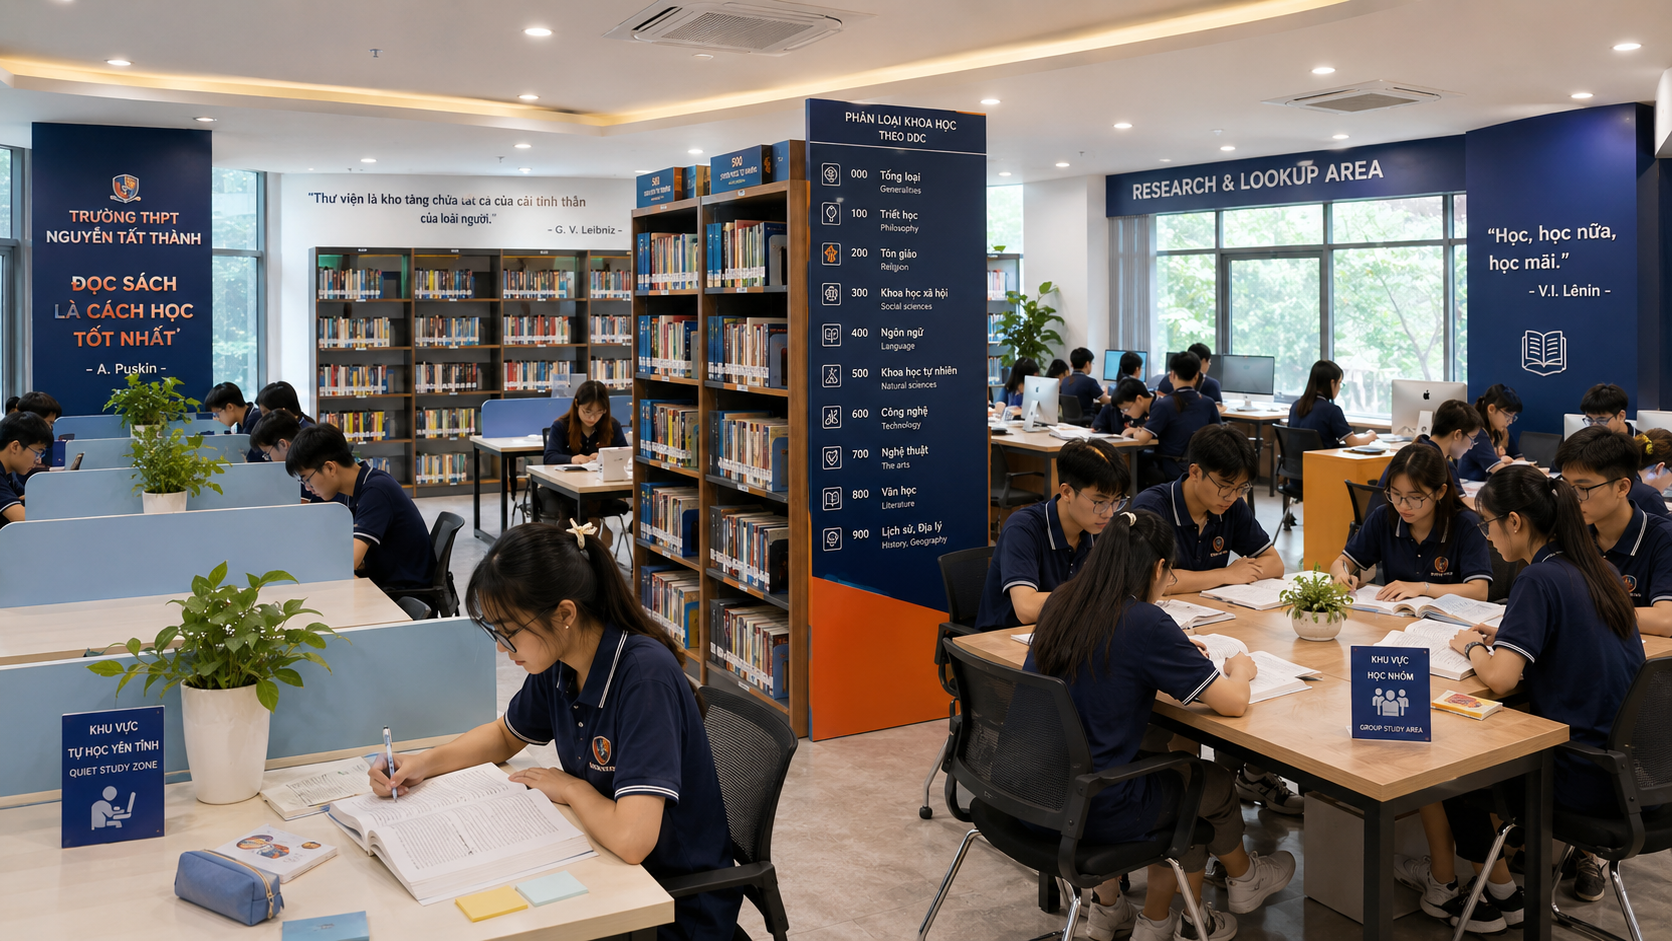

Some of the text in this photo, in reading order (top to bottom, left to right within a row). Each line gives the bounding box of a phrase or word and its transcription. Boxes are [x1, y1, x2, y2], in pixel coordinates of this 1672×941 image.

[877, 115, 902, 129] LOẠI
[904, 116, 933, 128] KHOA
[935, 119, 957, 132] HỌC
[878, 130, 926, 143] THEO DDC
[851, 169, 868, 179] 000
[1132, 159, 1384, 200] RESEARCH & LOOKUP AREA
[340, 193, 364, 206] viện
[381, 193, 402, 205] kho
[69, 208, 179, 224] TRƯỜNG THPT
[851, 208, 868, 218] 100
[902, 210, 918, 222] học
[117, 227, 146, 244] TẤT
[149, 229, 201, 246] THÀNH
[555, 225, 566, 235] G.
[568, 225, 579, 235] V.
[581, 225, 615, 235] Leibniz
[1538, 225, 1571, 245] học
[1577, 222, 1616, 241] nữa,
[851, 248, 868, 258] 200
[1489, 255, 1519, 274] học
[71, 272, 177, 295] ĐỌC SÁCH
[1538, 285, 1558, 297] V.I.
[1563, 283, 1600, 297] Lênin
[851, 288, 868, 297] 300
[880, 288, 903, 297] Khoa
[905, 288, 921, 300] học
[54, 300, 194, 323] LÀ CÁCH HỌC
[880, 302, 902, 311] Social
[73, 325, 114, 347] TỐT
[851, 328, 868, 338] 400
[881, 342, 915, 352] Language
[97, 364, 110, 375] A.
[115, 362, 157, 375] Puskin
[851, 368, 868, 378] 500
[881, 367, 904, 378] Khoa
[905, 366, 922, 379] học
[881, 380, 937, 390] Natural sciences
[851, 408, 869, 418] 600
[881, 421, 922, 430] Technology
[852, 449, 869, 459] 700
[881, 460, 910, 470] The arts
[852, 489, 869, 499] 800
[900, 486, 917, 498] học
[881, 500, 915, 510] Literature
[852, 529, 869, 539] 900
[910, 535, 948, 548] Geography
[1371, 655, 1409, 667] KHU VỰC
[1367, 671, 1386, 682] HỌC
[89, 720, 138, 736] KHU VỰC
[1384, 725, 1405, 733] STUDY
[68, 747, 84, 760] TỰ
[85, 745, 109, 759] HỌC
[69, 760, 158, 779] QUIET STUDY ZONE
